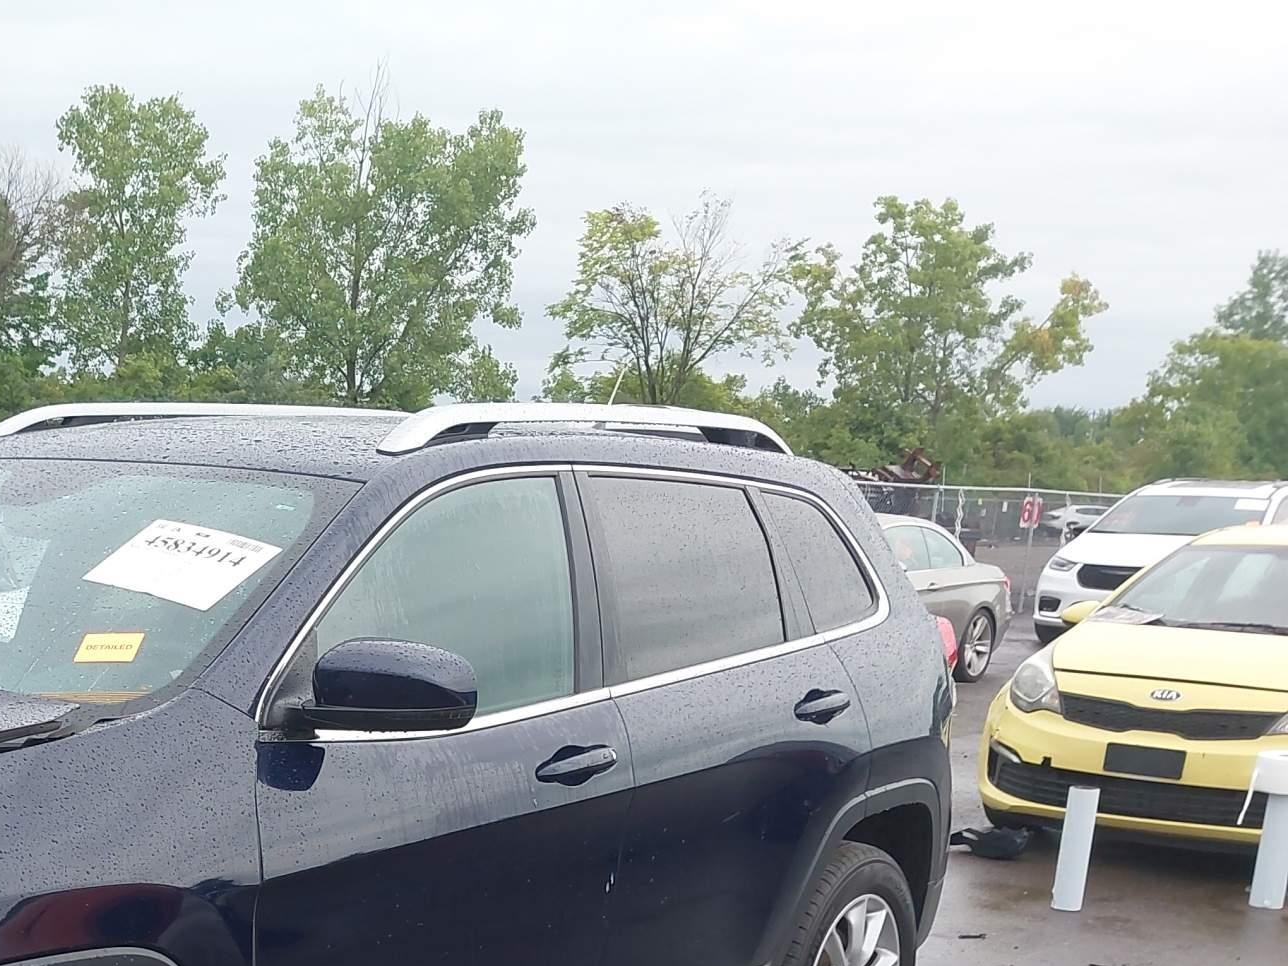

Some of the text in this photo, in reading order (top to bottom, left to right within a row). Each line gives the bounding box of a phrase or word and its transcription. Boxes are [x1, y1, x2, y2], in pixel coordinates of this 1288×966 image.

[145, 535, 247, 568] 45834914
[85, 643, 133, 651] DETAILED
[1152, 690, 1178, 700] KIA
